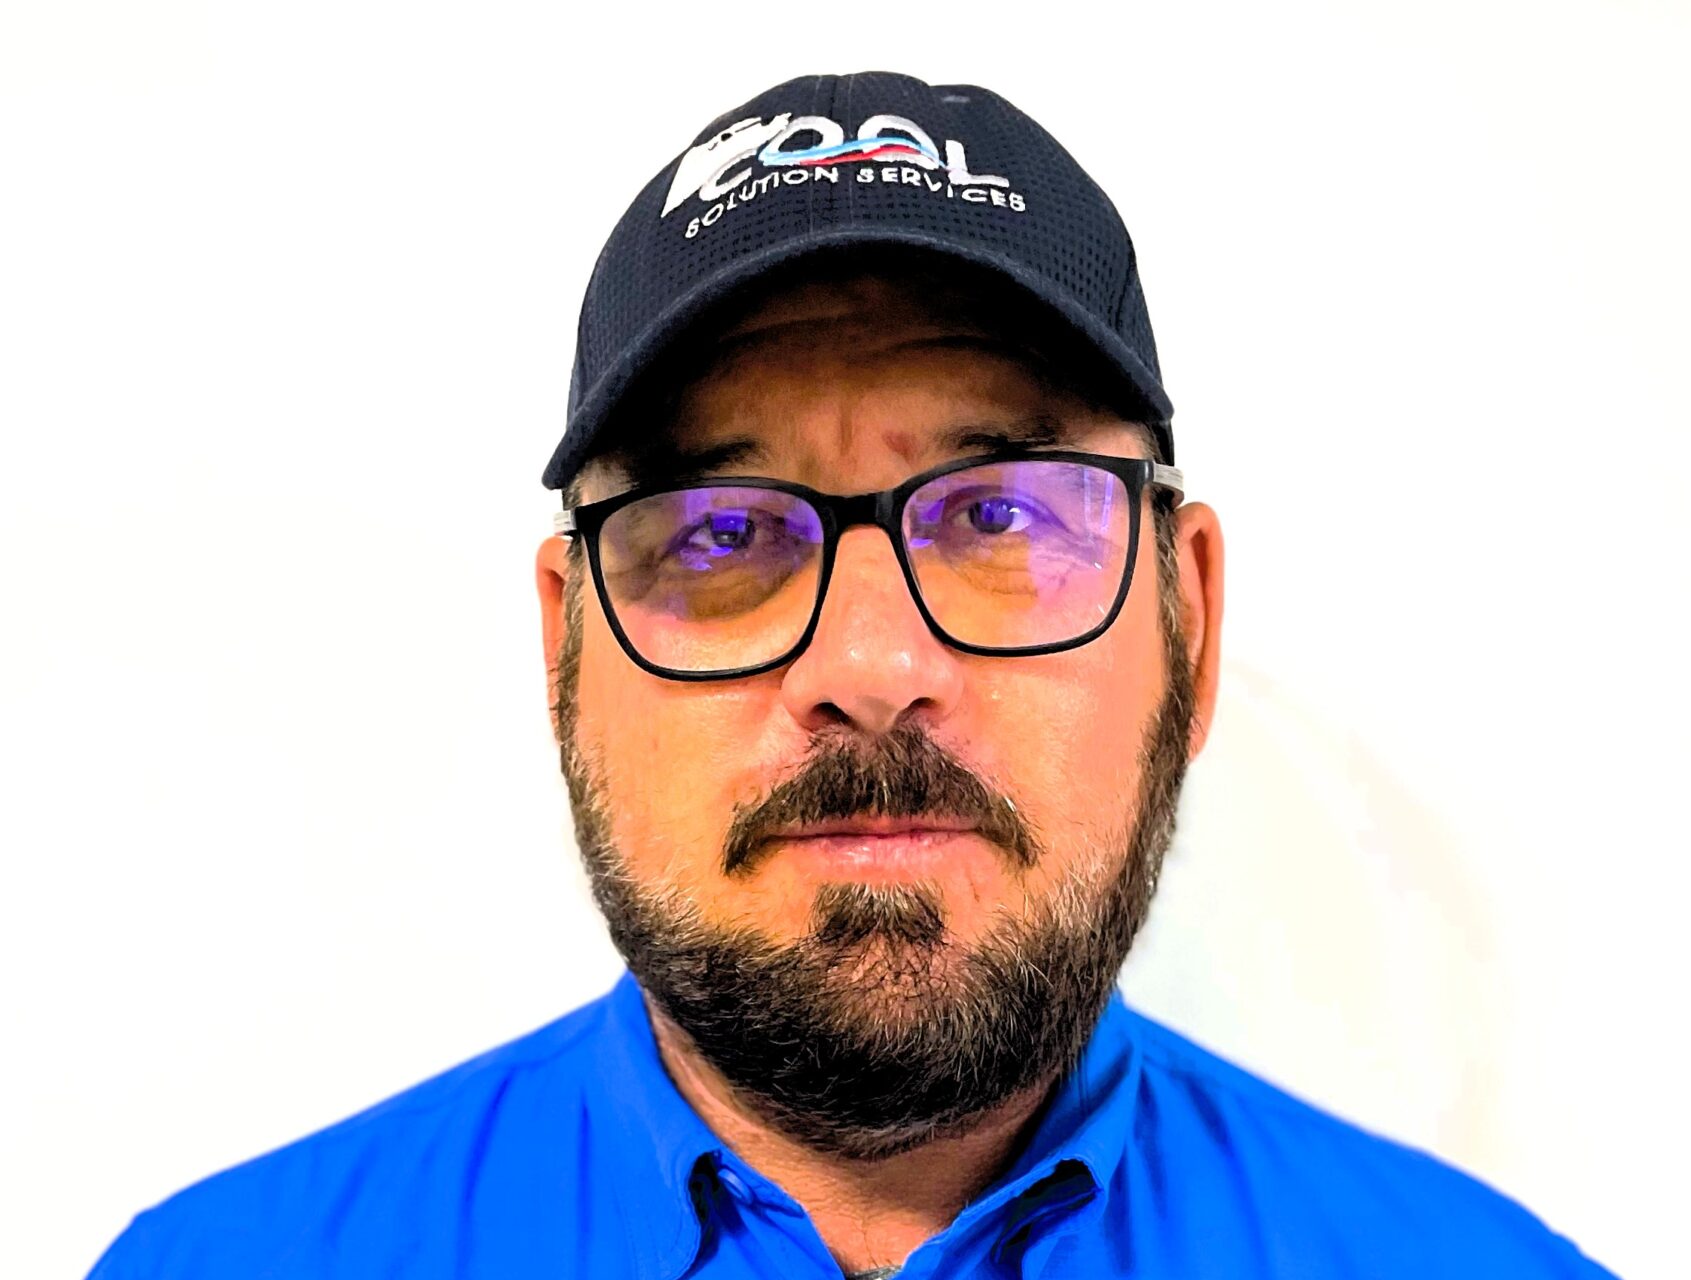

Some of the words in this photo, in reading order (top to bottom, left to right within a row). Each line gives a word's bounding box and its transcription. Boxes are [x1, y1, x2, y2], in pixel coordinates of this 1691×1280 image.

[699, 114, 1010, 201] COOL
[685, 166, 838, 238] SOLUTION
[856, 167, 1026, 212] SERVICES
